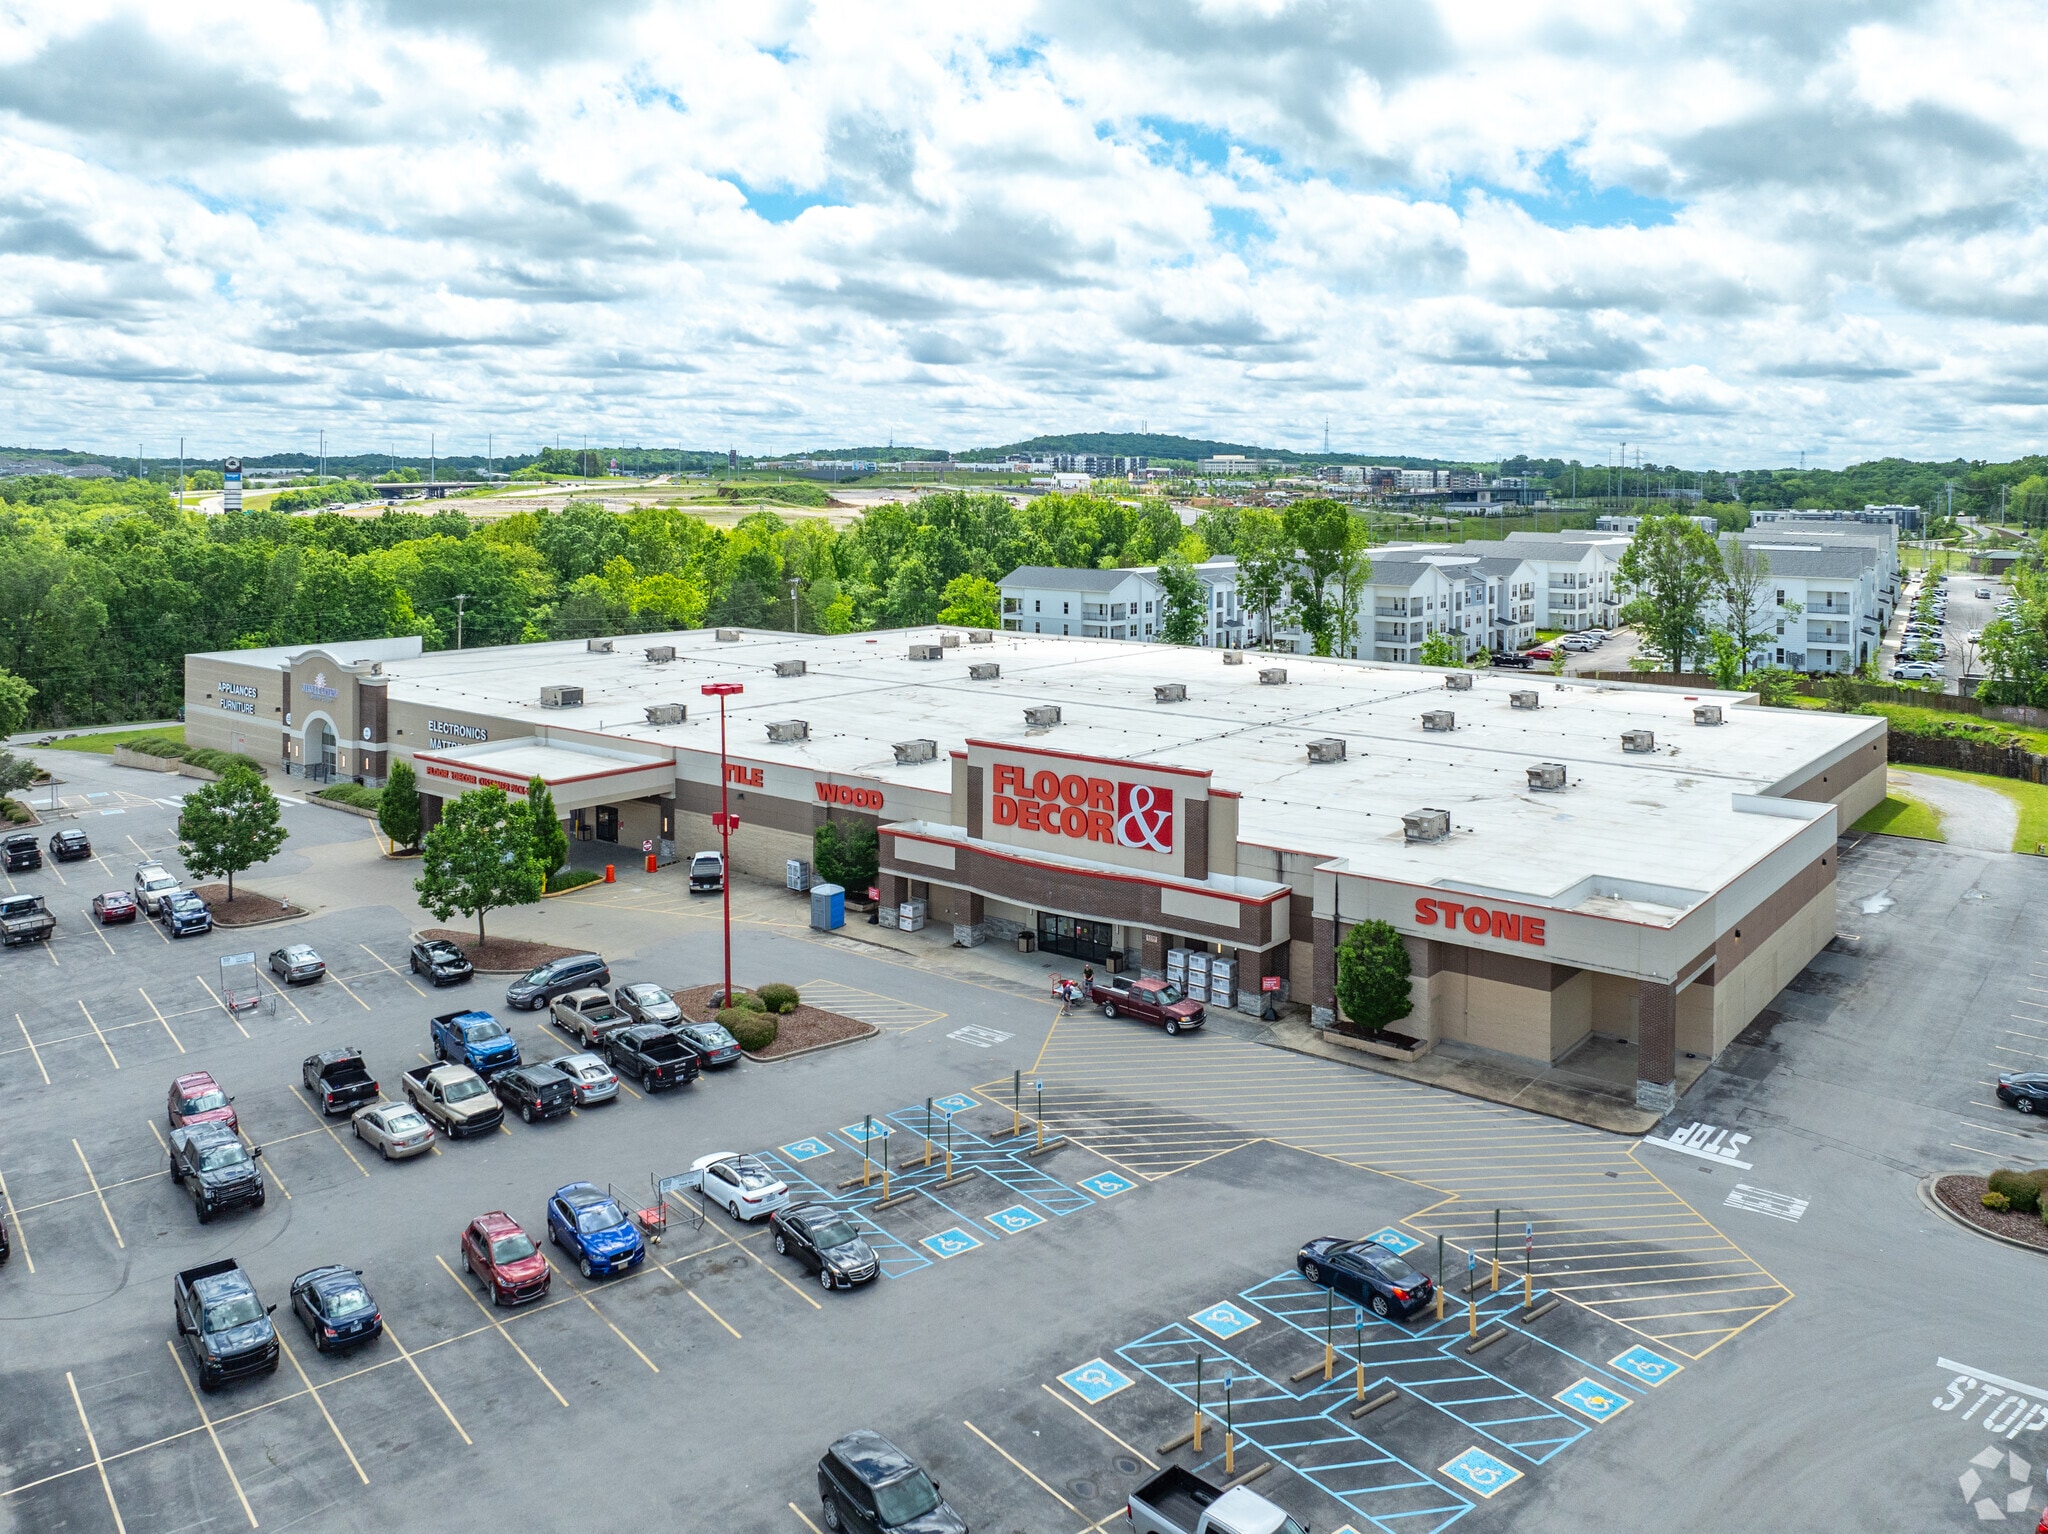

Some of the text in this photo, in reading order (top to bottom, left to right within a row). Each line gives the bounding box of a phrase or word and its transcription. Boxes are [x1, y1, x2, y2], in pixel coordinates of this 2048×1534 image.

[217, 682, 258, 699] APPLIANCES
[220, 698, 256, 715] FURNITURE
[428, 720, 488, 741] ELECTRONICS
[452, 771, 477, 785] DECOR
[721, 763, 764, 788] TILE
[992, 763, 1115, 811] FLOOR
[815, 781, 884, 810] WOOD
[992, 794, 1115, 844] DECOR
[1117, 784, 1172, 854] &
[1415, 897, 1546, 946] STONE
[1668, 1121, 1752, 1159] STOP
[1722, 1183, 1810, 1223] YIELD
[1932, 1375, 2048, 1440] STOP
